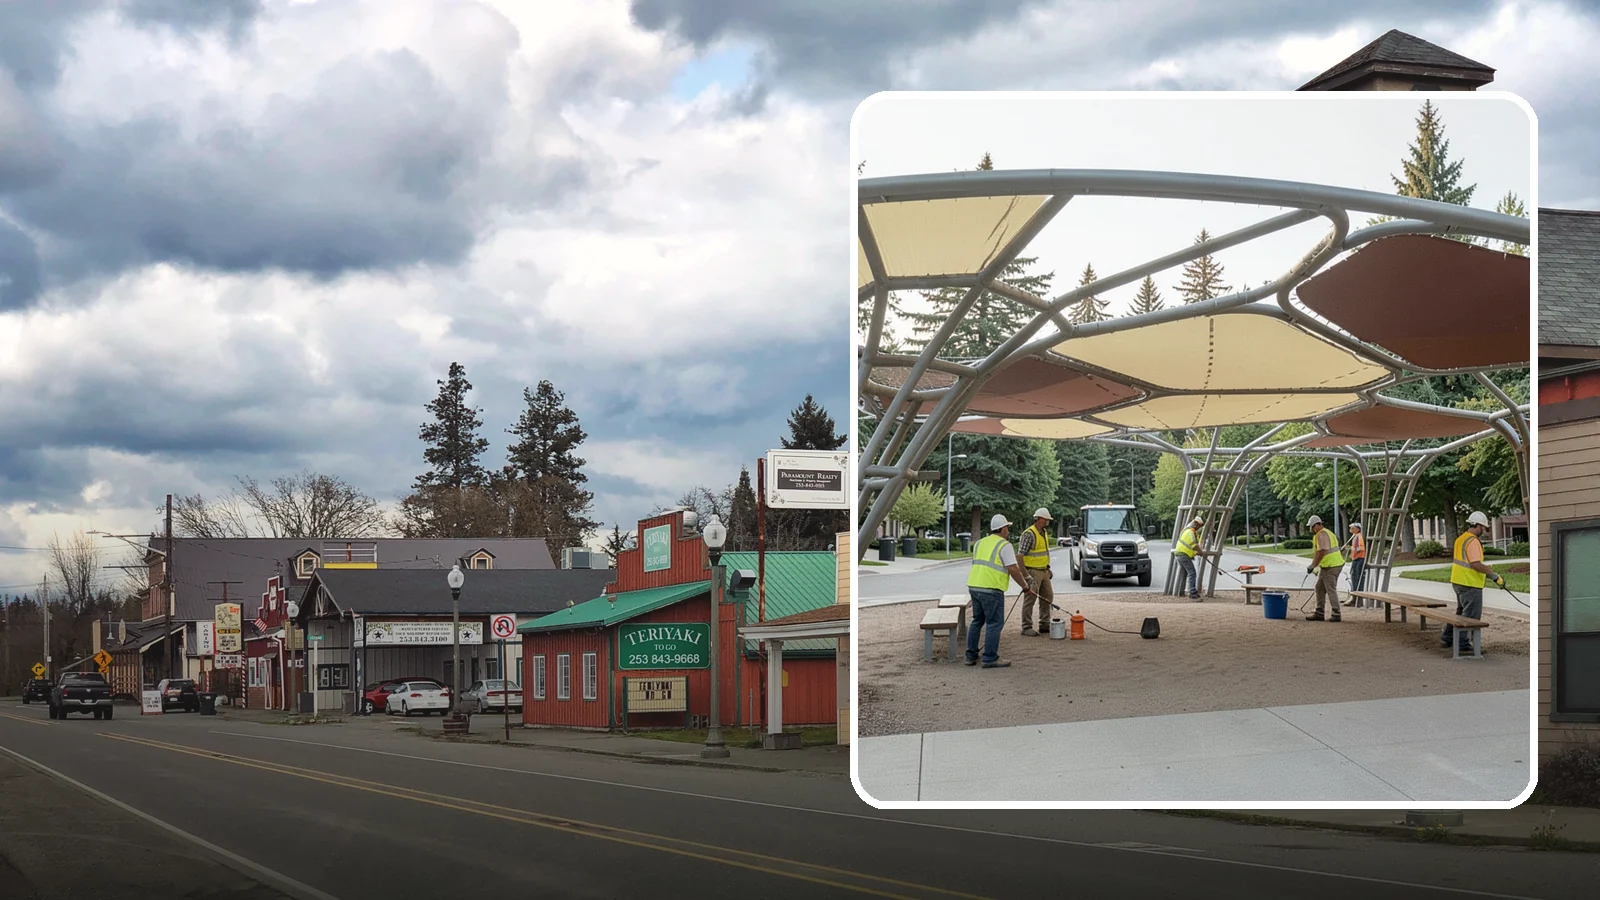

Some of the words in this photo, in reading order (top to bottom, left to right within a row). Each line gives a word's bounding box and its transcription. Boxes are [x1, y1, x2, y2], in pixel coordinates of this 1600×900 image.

[625, 627, 702, 645] TERIYAKI
[629, 654, 648, 664] 253
[652, 654, 700, 664] 843-9668
